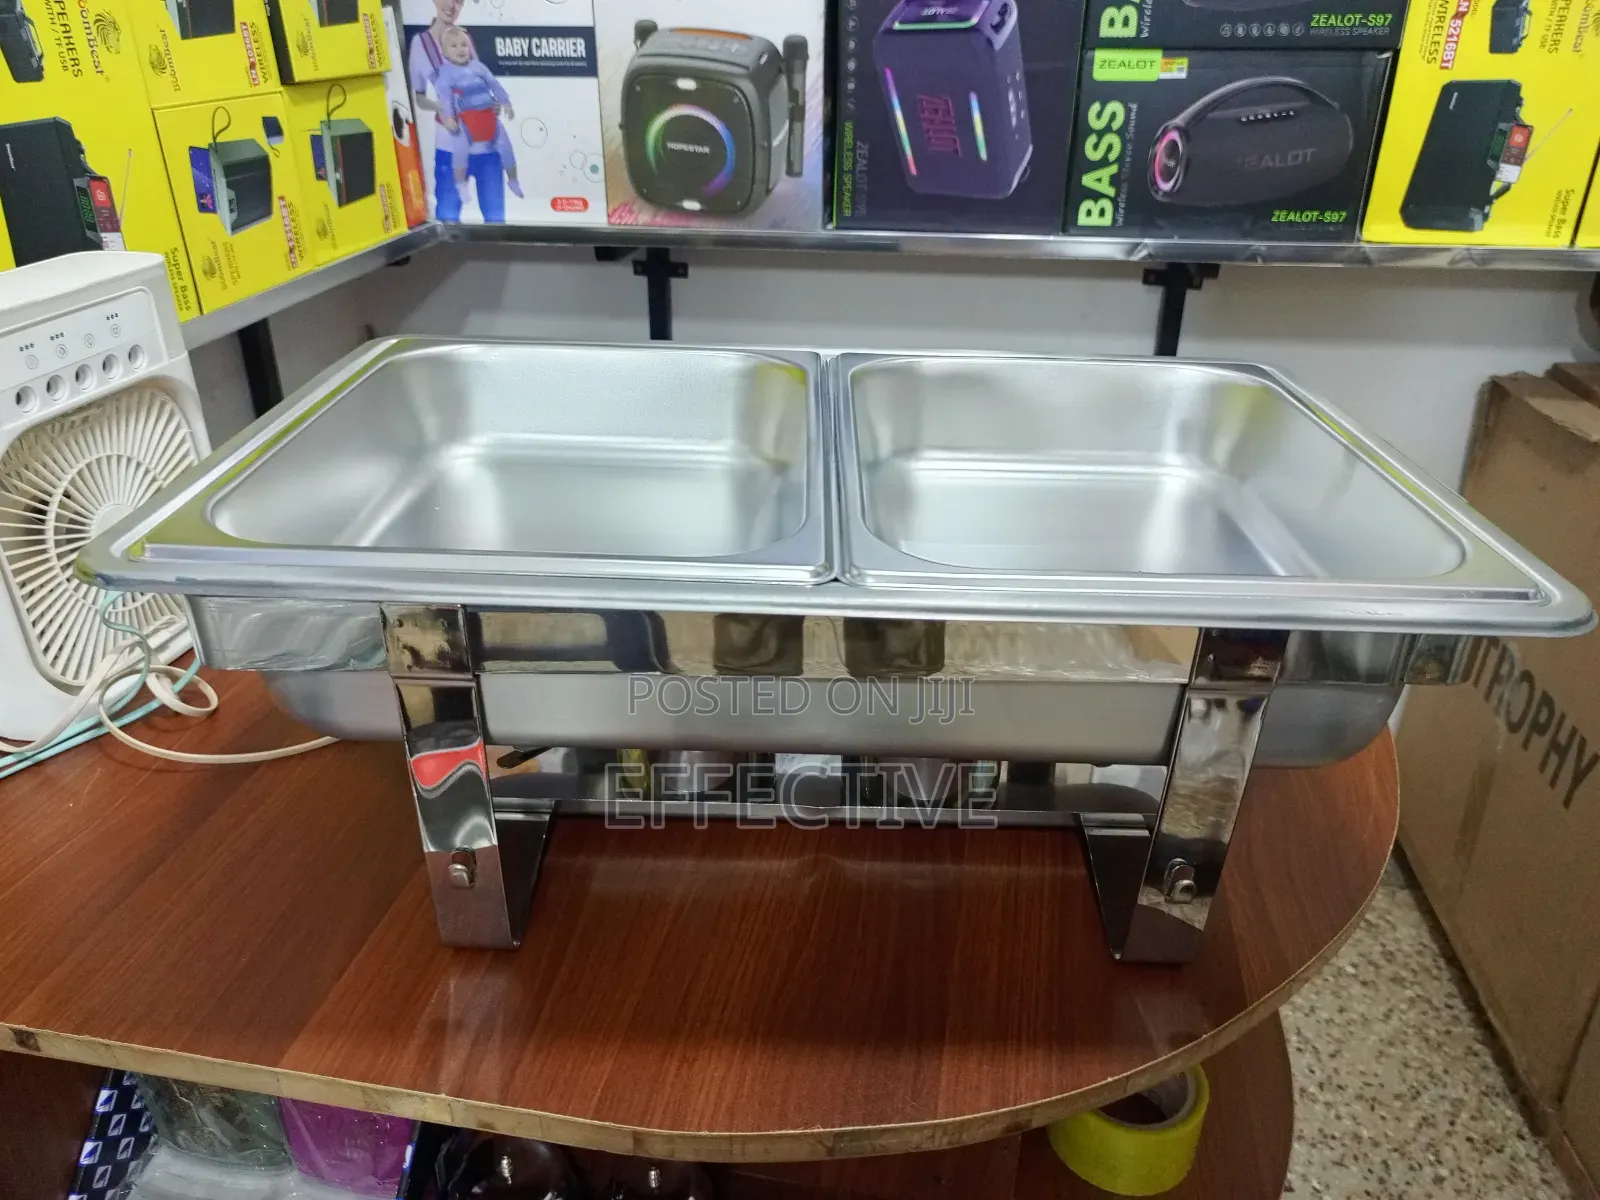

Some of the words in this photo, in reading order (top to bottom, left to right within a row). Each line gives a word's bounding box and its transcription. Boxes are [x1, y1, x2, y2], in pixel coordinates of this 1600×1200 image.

[1310, 13, 1393, 27] ZEALOT-S97
[1352, 27, 1390, 36] SPEAKER
[496, 37, 530, 57] BABY
[531, 37, 586, 58] CARRIER
[1440, 18, 1462, 69] 5216BT
[58, 51, 69, 72] USB
[1098, 59, 1157, 70] ZEALOT
[1125, 102, 1139, 140] Sound
[1077, 100, 1125, 226] BASS
[1238, 148, 1317, 170] EALOT
[1271, 210, 1348, 223] ZEALOT-S97
[170, 247, 184, 281] Super
[180, 285, 193, 312] Bass
